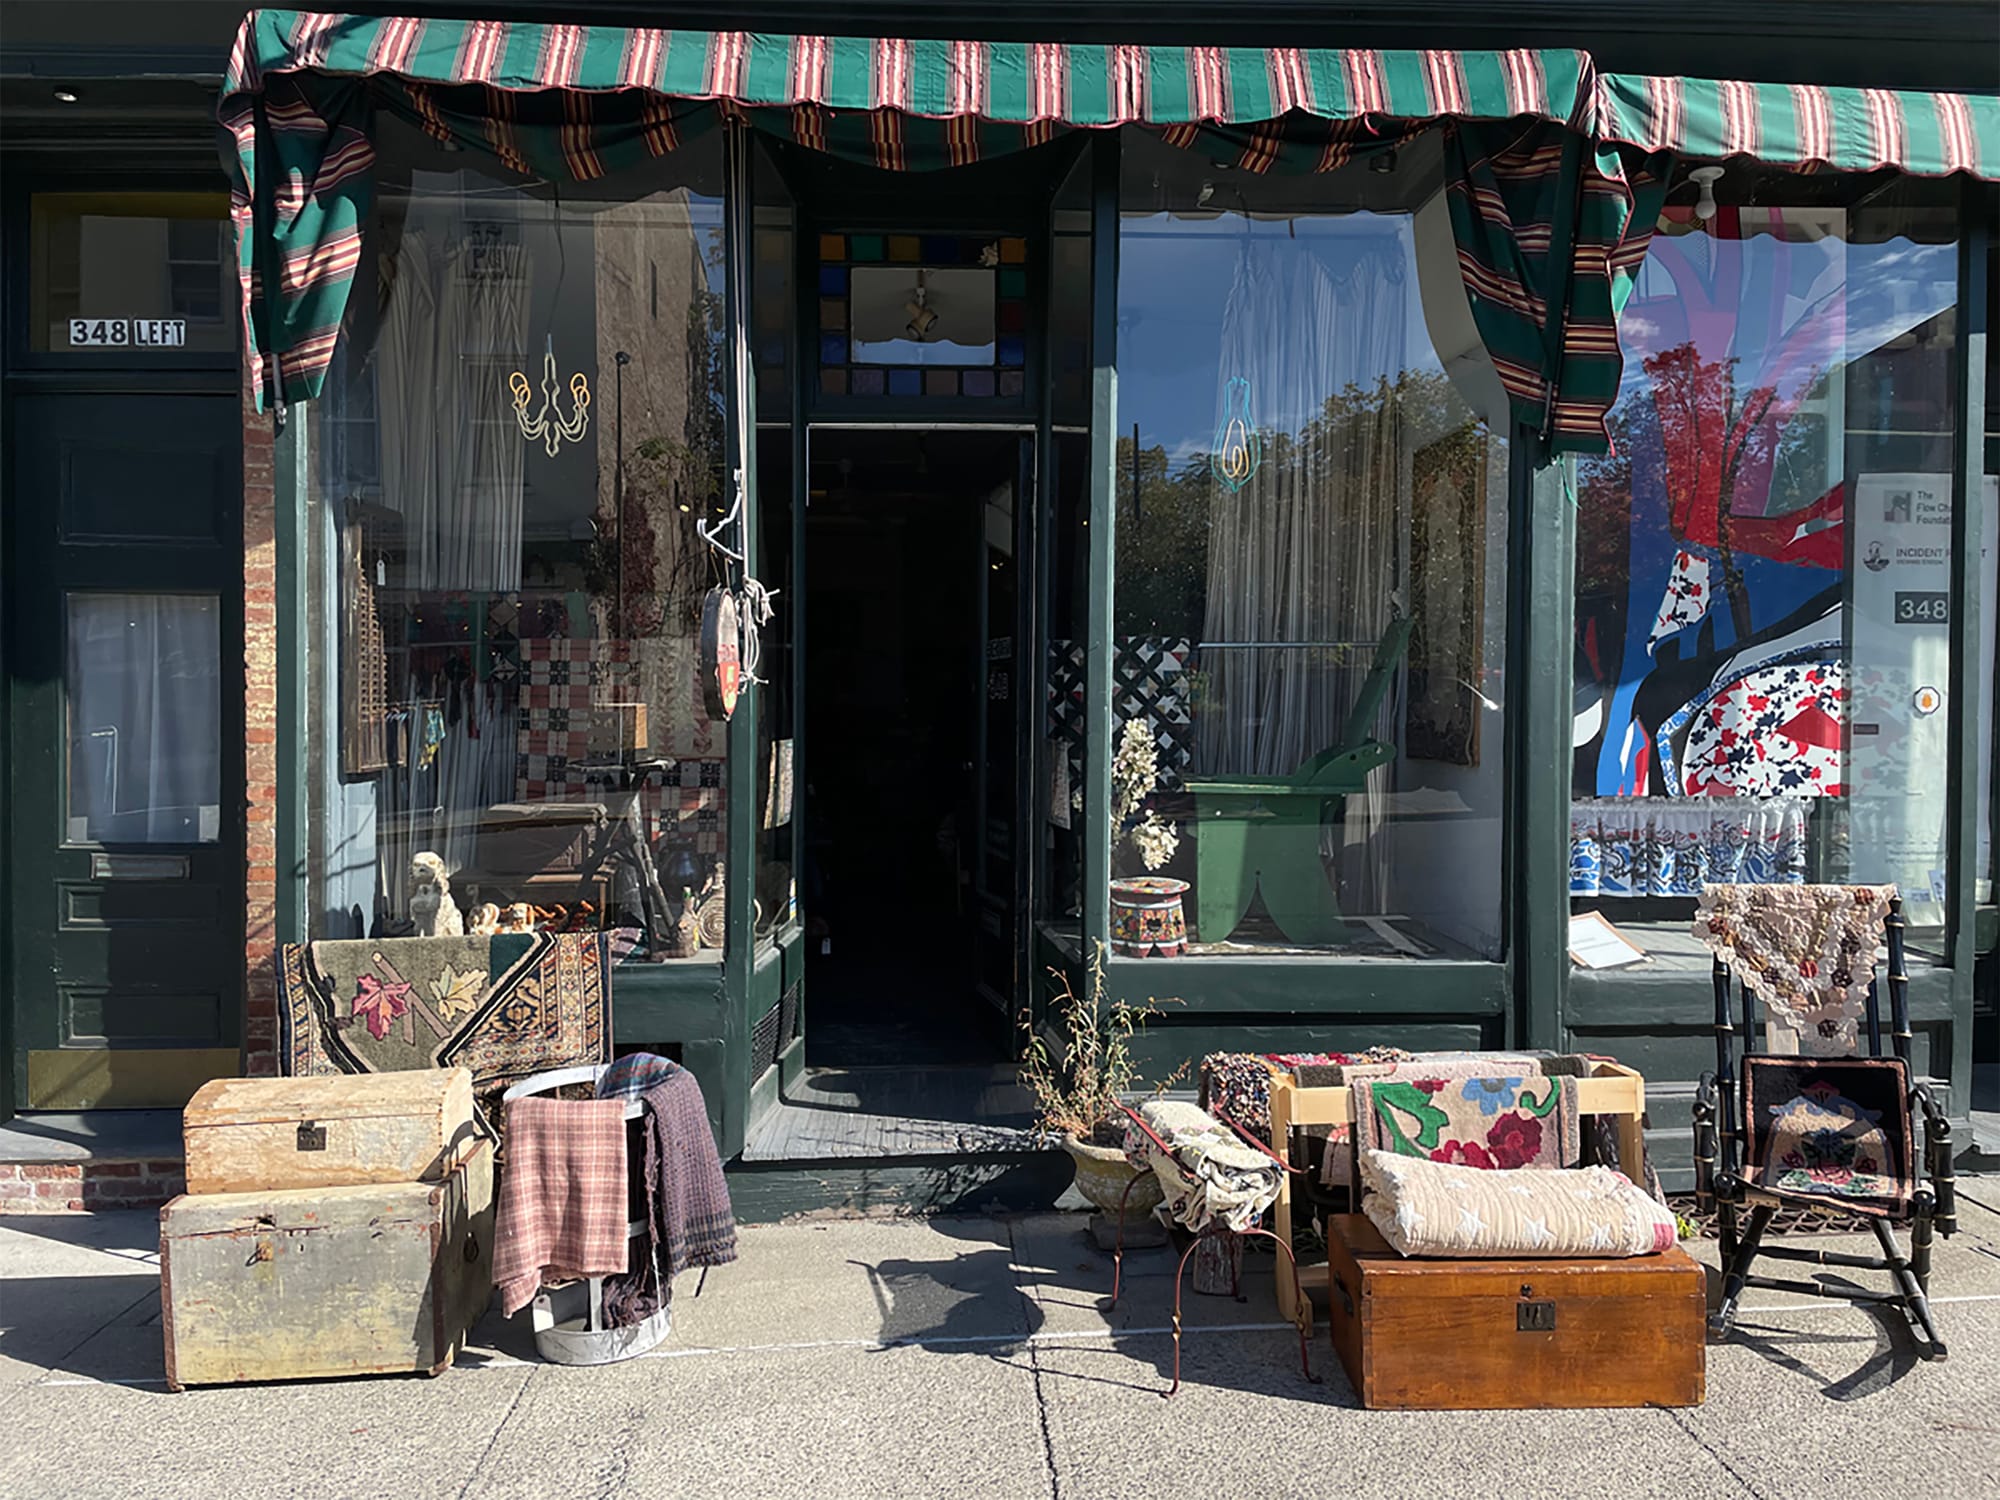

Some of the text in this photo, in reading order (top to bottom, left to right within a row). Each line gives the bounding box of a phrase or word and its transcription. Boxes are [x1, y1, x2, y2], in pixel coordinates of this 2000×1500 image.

[72, 321, 183, 344] 348 LEFT
[1917, 490, 1934, 499] The
[1916, 502, 1936, 512] Flow
[1896, 548, 1944, 557] INCIDENT
[1900, 600, 1947, 619] 348
